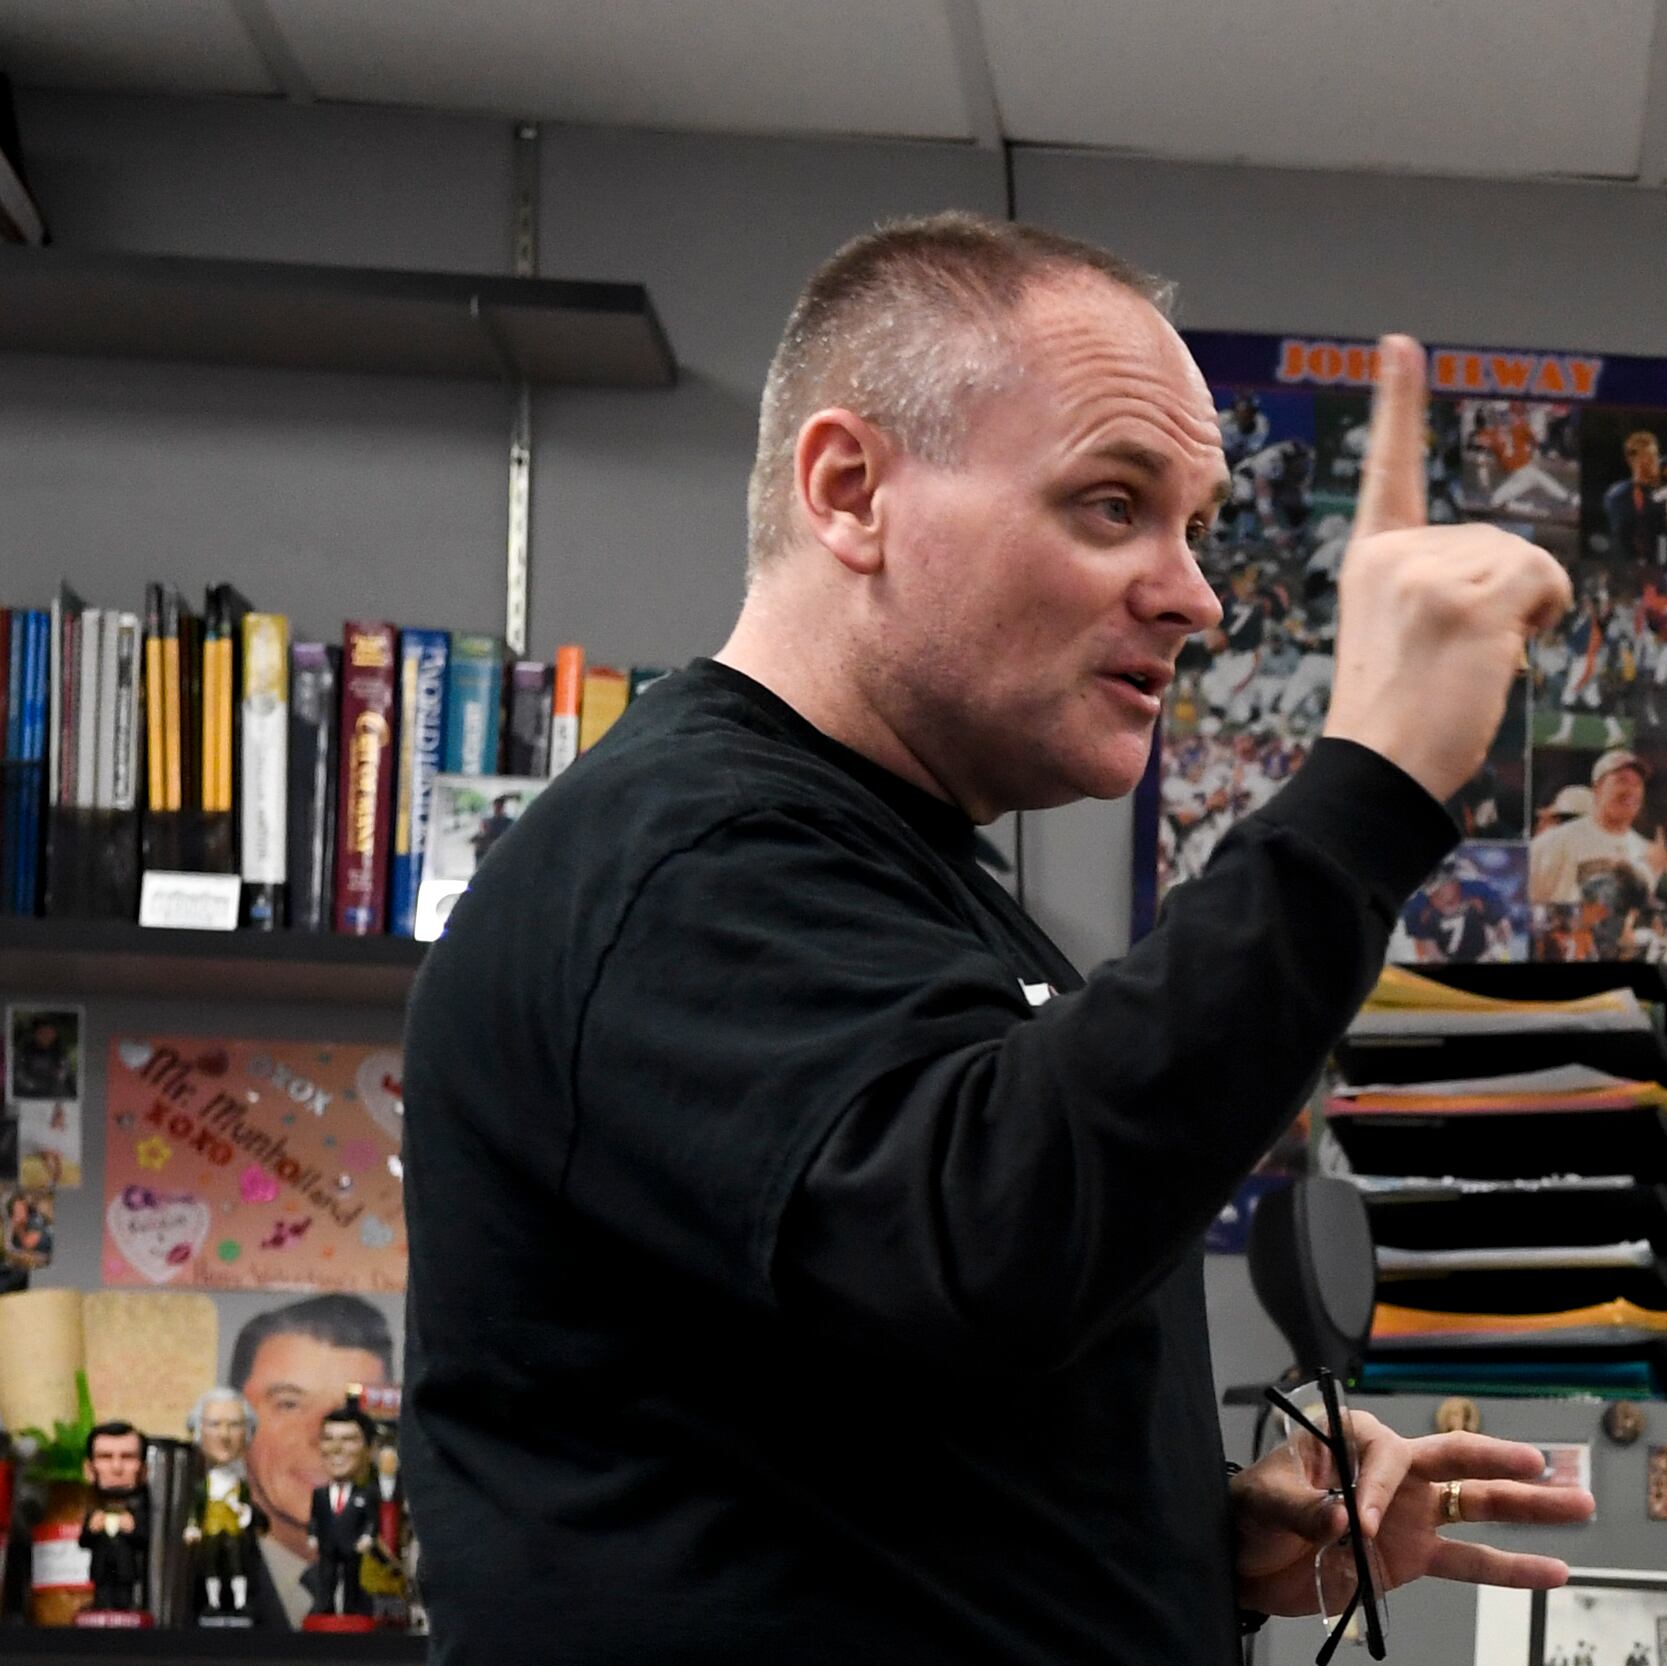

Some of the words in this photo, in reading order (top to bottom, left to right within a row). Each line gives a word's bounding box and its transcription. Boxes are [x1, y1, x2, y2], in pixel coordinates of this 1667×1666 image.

[1277, 340, 1385, 383] JOH
[1430, 351, 1603, 398] ELWAY
[1441, 913, 1467, 955] 7
